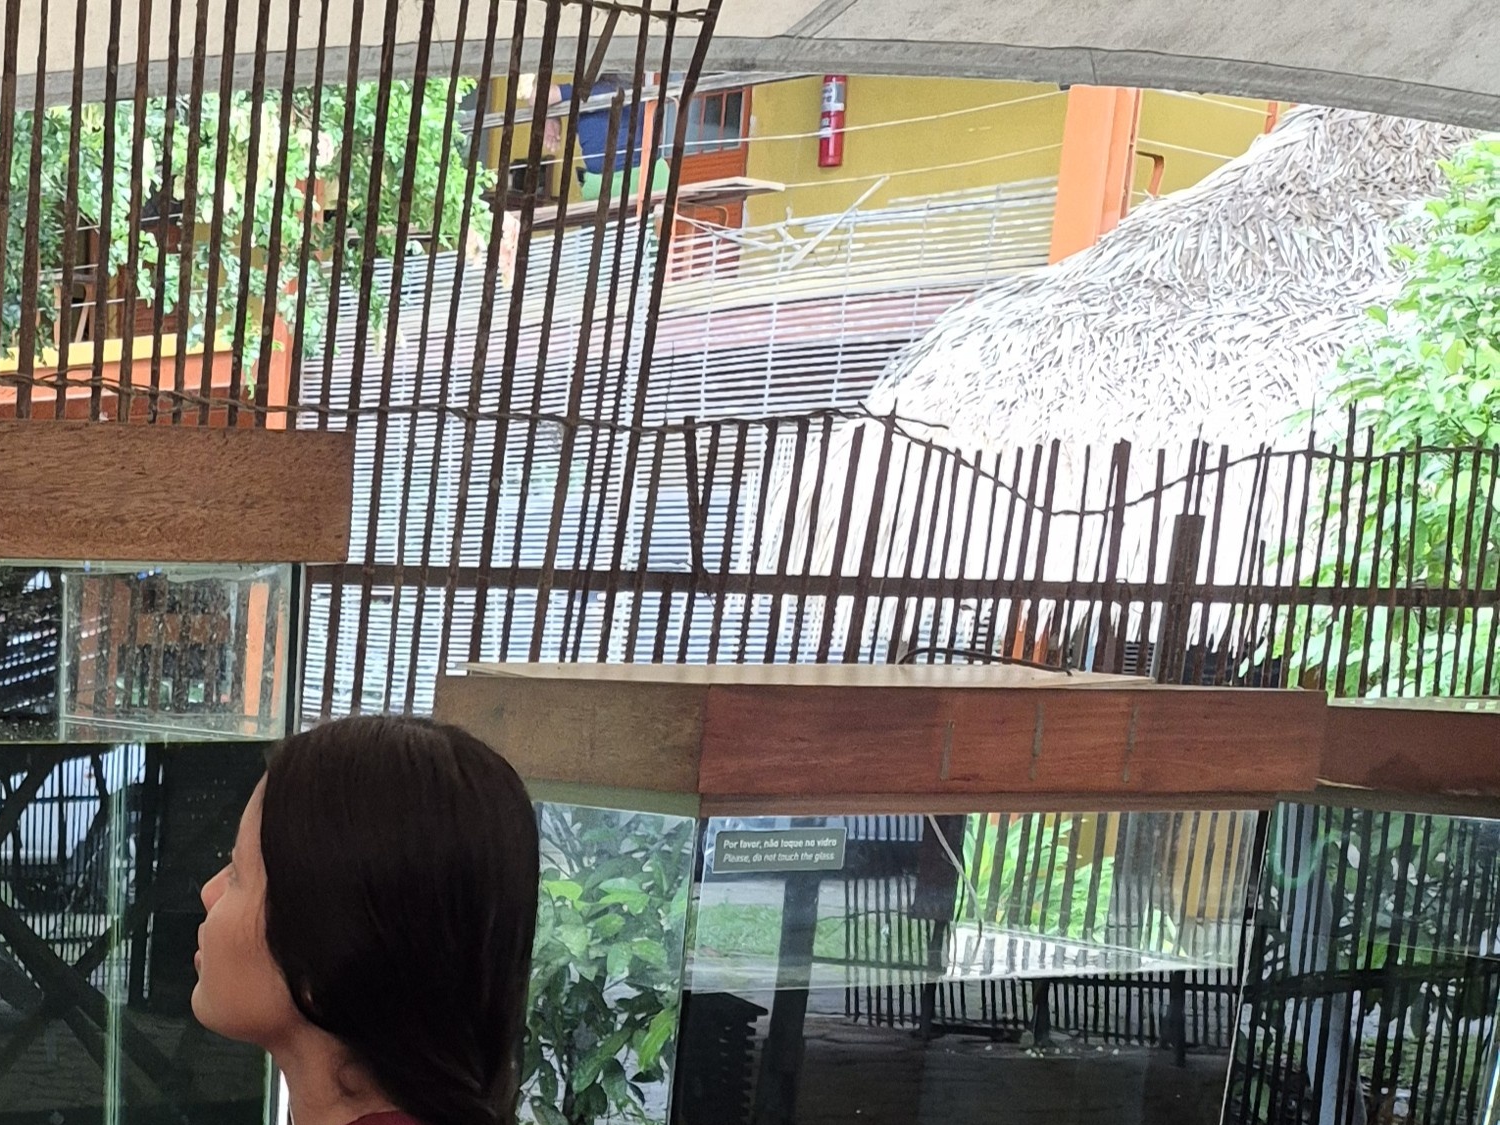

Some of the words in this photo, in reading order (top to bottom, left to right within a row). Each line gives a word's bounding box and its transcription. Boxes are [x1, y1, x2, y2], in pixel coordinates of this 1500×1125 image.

[723, 840, 738, 849] Por
[739, 840, 762, 849] favor,
[763, 839, 779, 848] não
[780, 840, 803, 848] toque
[817, 838, 837, 847] vidro
[723, 853, 750, 863] Please,
[752, 853, 763, 862] do
[763, 853, 777, 862] not
[777, 852, 799, 861] touch
[800, 852, 814, 861] the
[813, 852, 835, 863] glass
